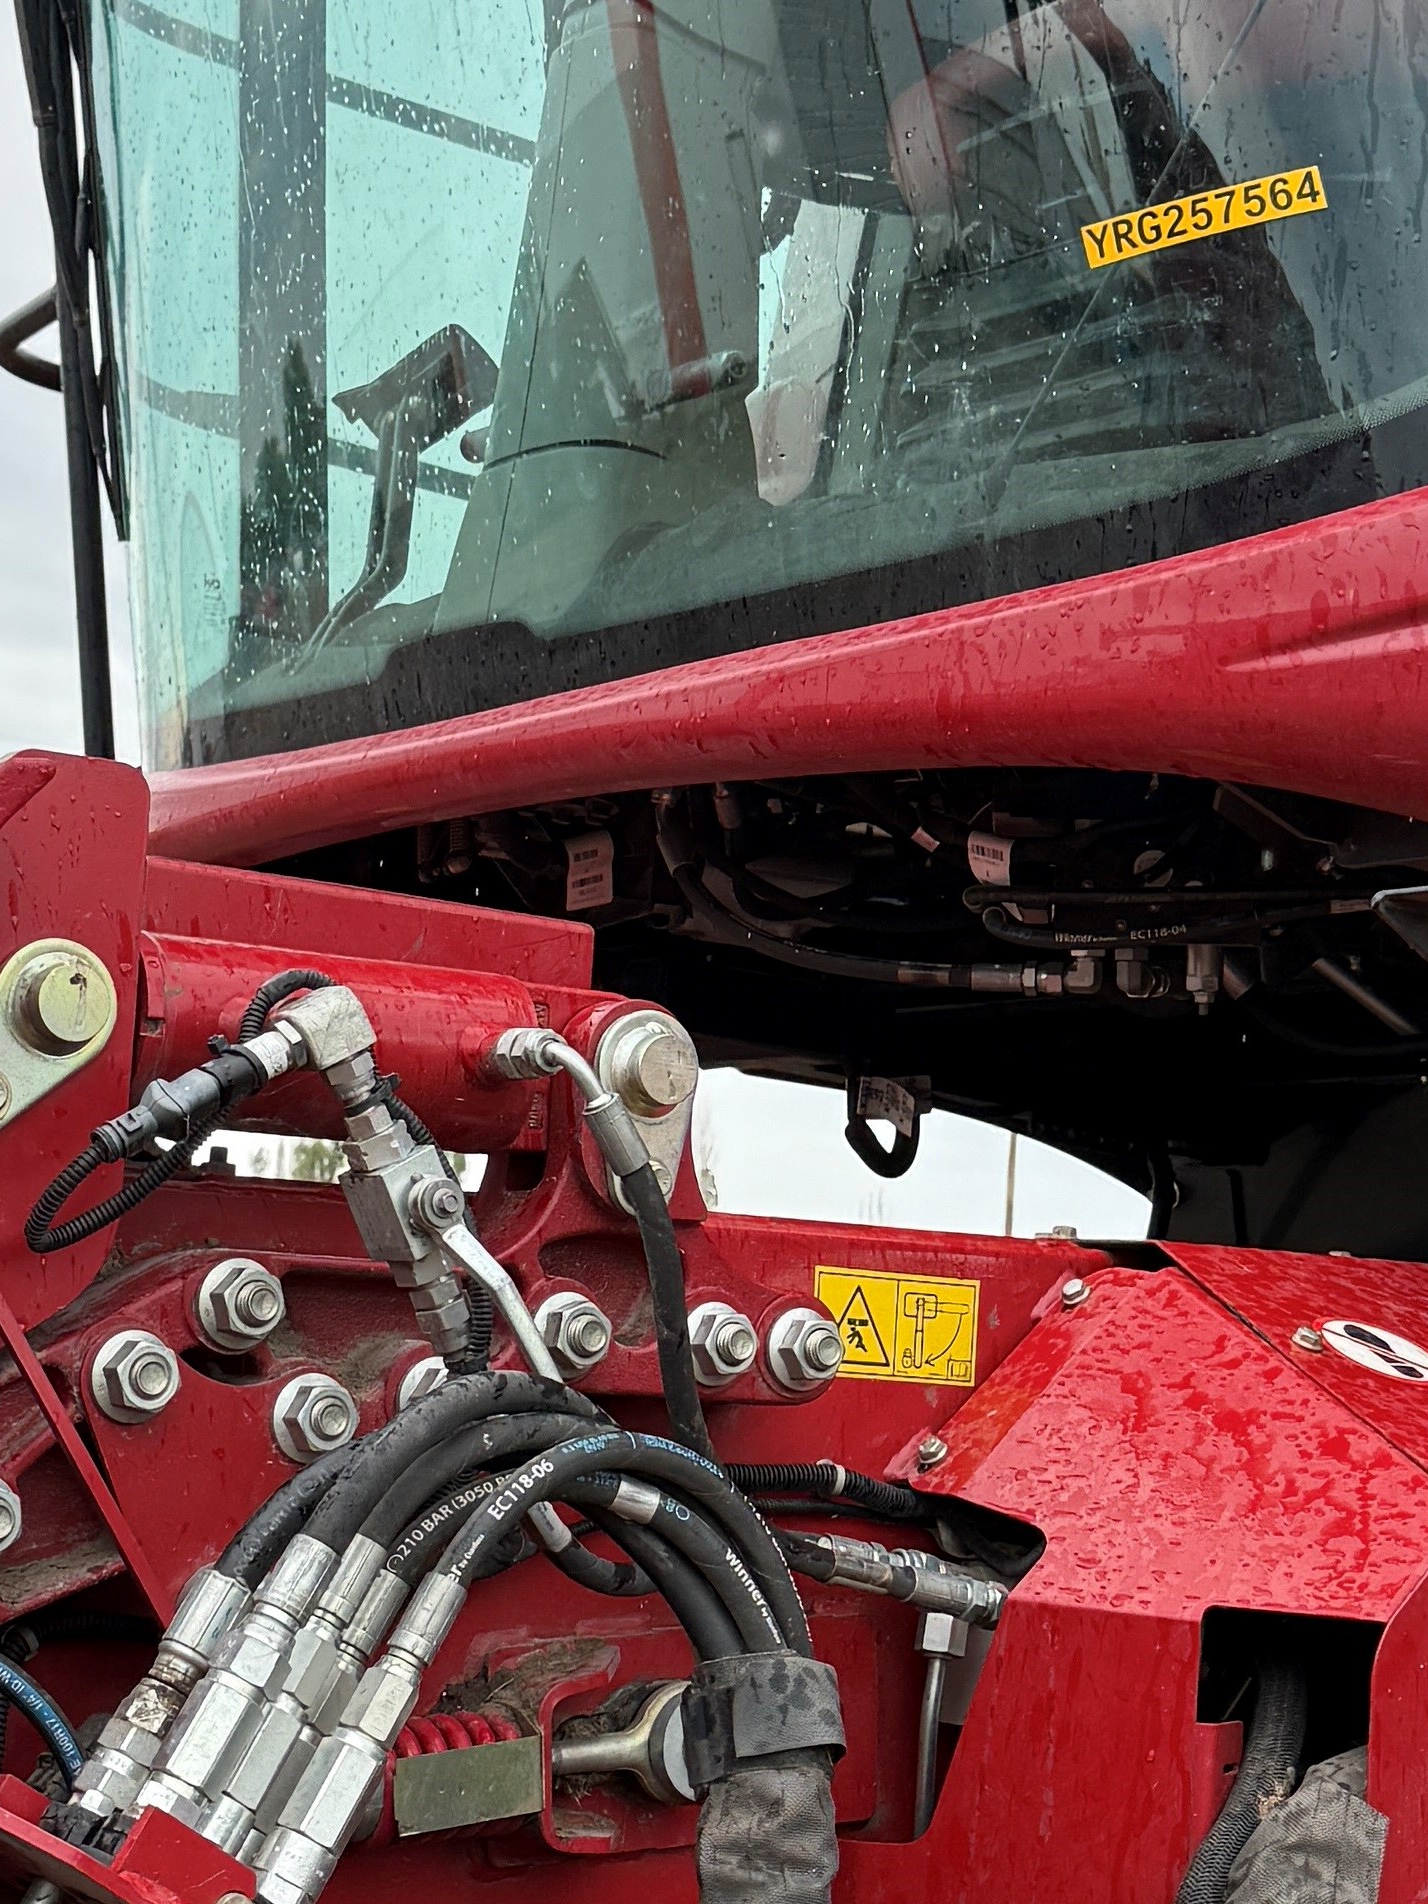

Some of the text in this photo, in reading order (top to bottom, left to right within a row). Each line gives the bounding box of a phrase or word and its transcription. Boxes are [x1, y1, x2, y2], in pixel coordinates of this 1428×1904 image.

[1085, 170, 1320, 259] YRG257564
[397, 1529, 424, 1557] 210
[421, 1504, 454, 1533] BAR
[451, 1482, 494, 1510] (3050
[487, 1458, 554, 1521] EC118-06
[45, 1718, 75, 1757] 100R17
